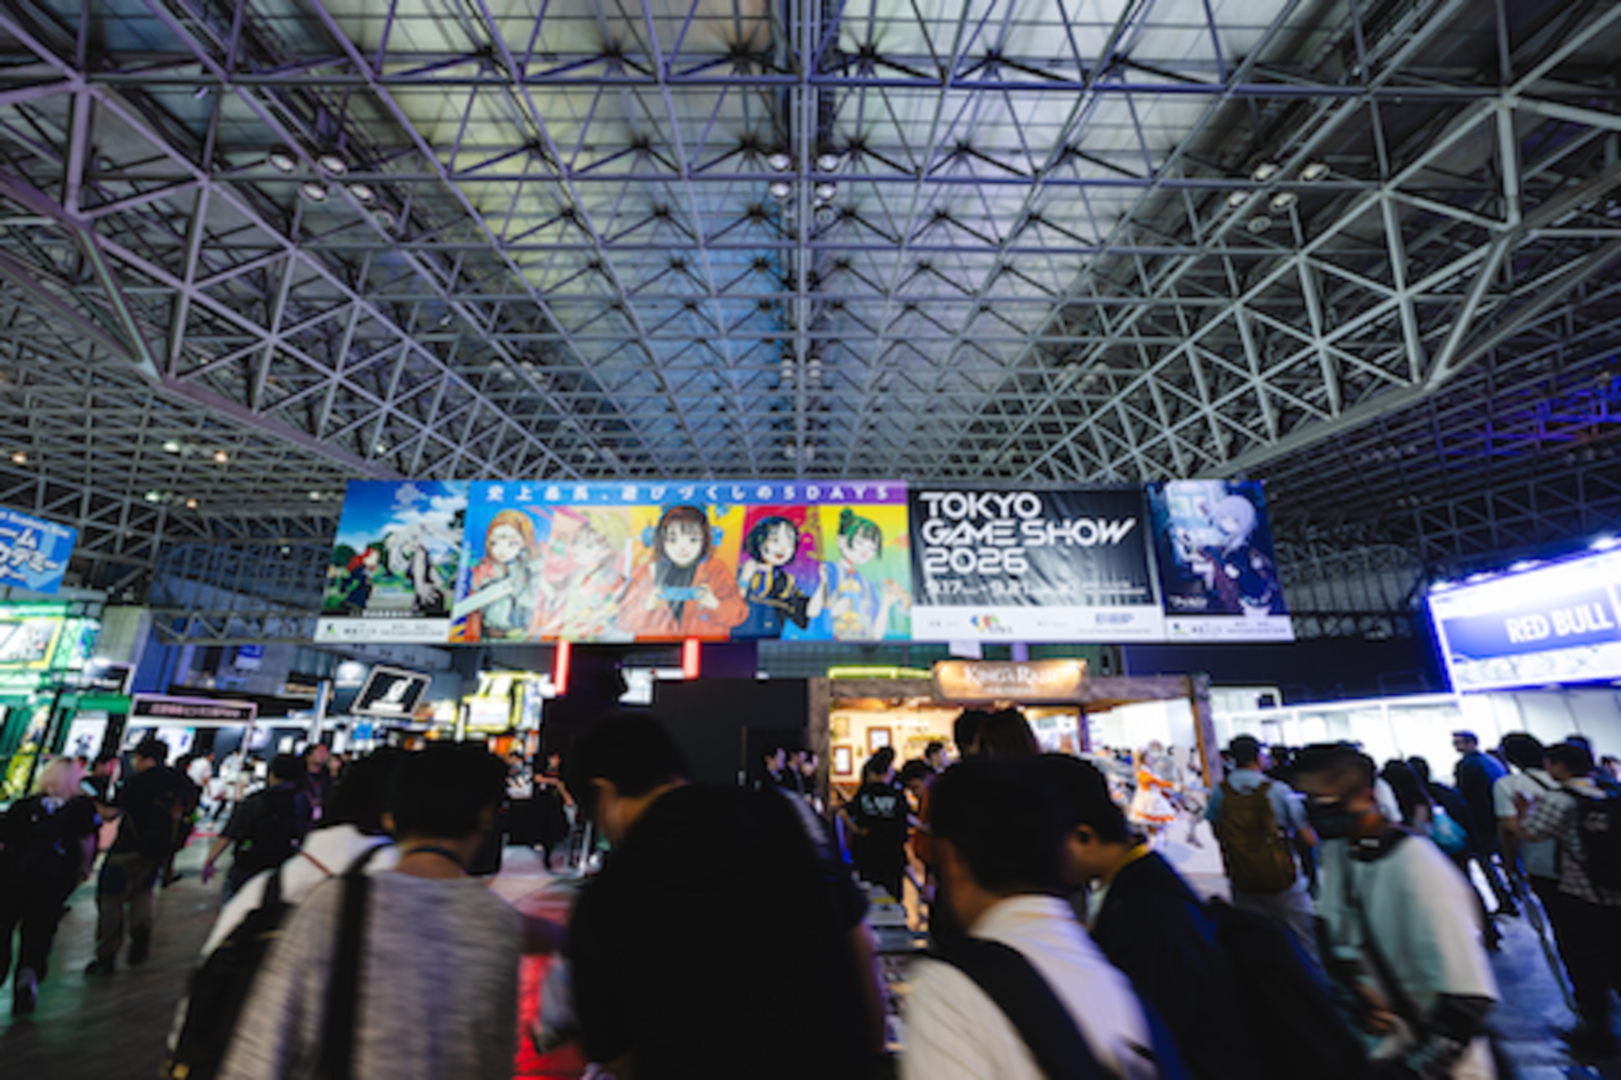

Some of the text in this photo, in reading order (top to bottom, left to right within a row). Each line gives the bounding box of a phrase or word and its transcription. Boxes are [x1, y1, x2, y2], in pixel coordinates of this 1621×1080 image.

[919, 491, 1042, 519] TOKYO
[922, 517, 1136, 546] GAME SHOW
[925, 547, 1029, 575] 2026
[1505, 602, 1616, 644] RED BULL
